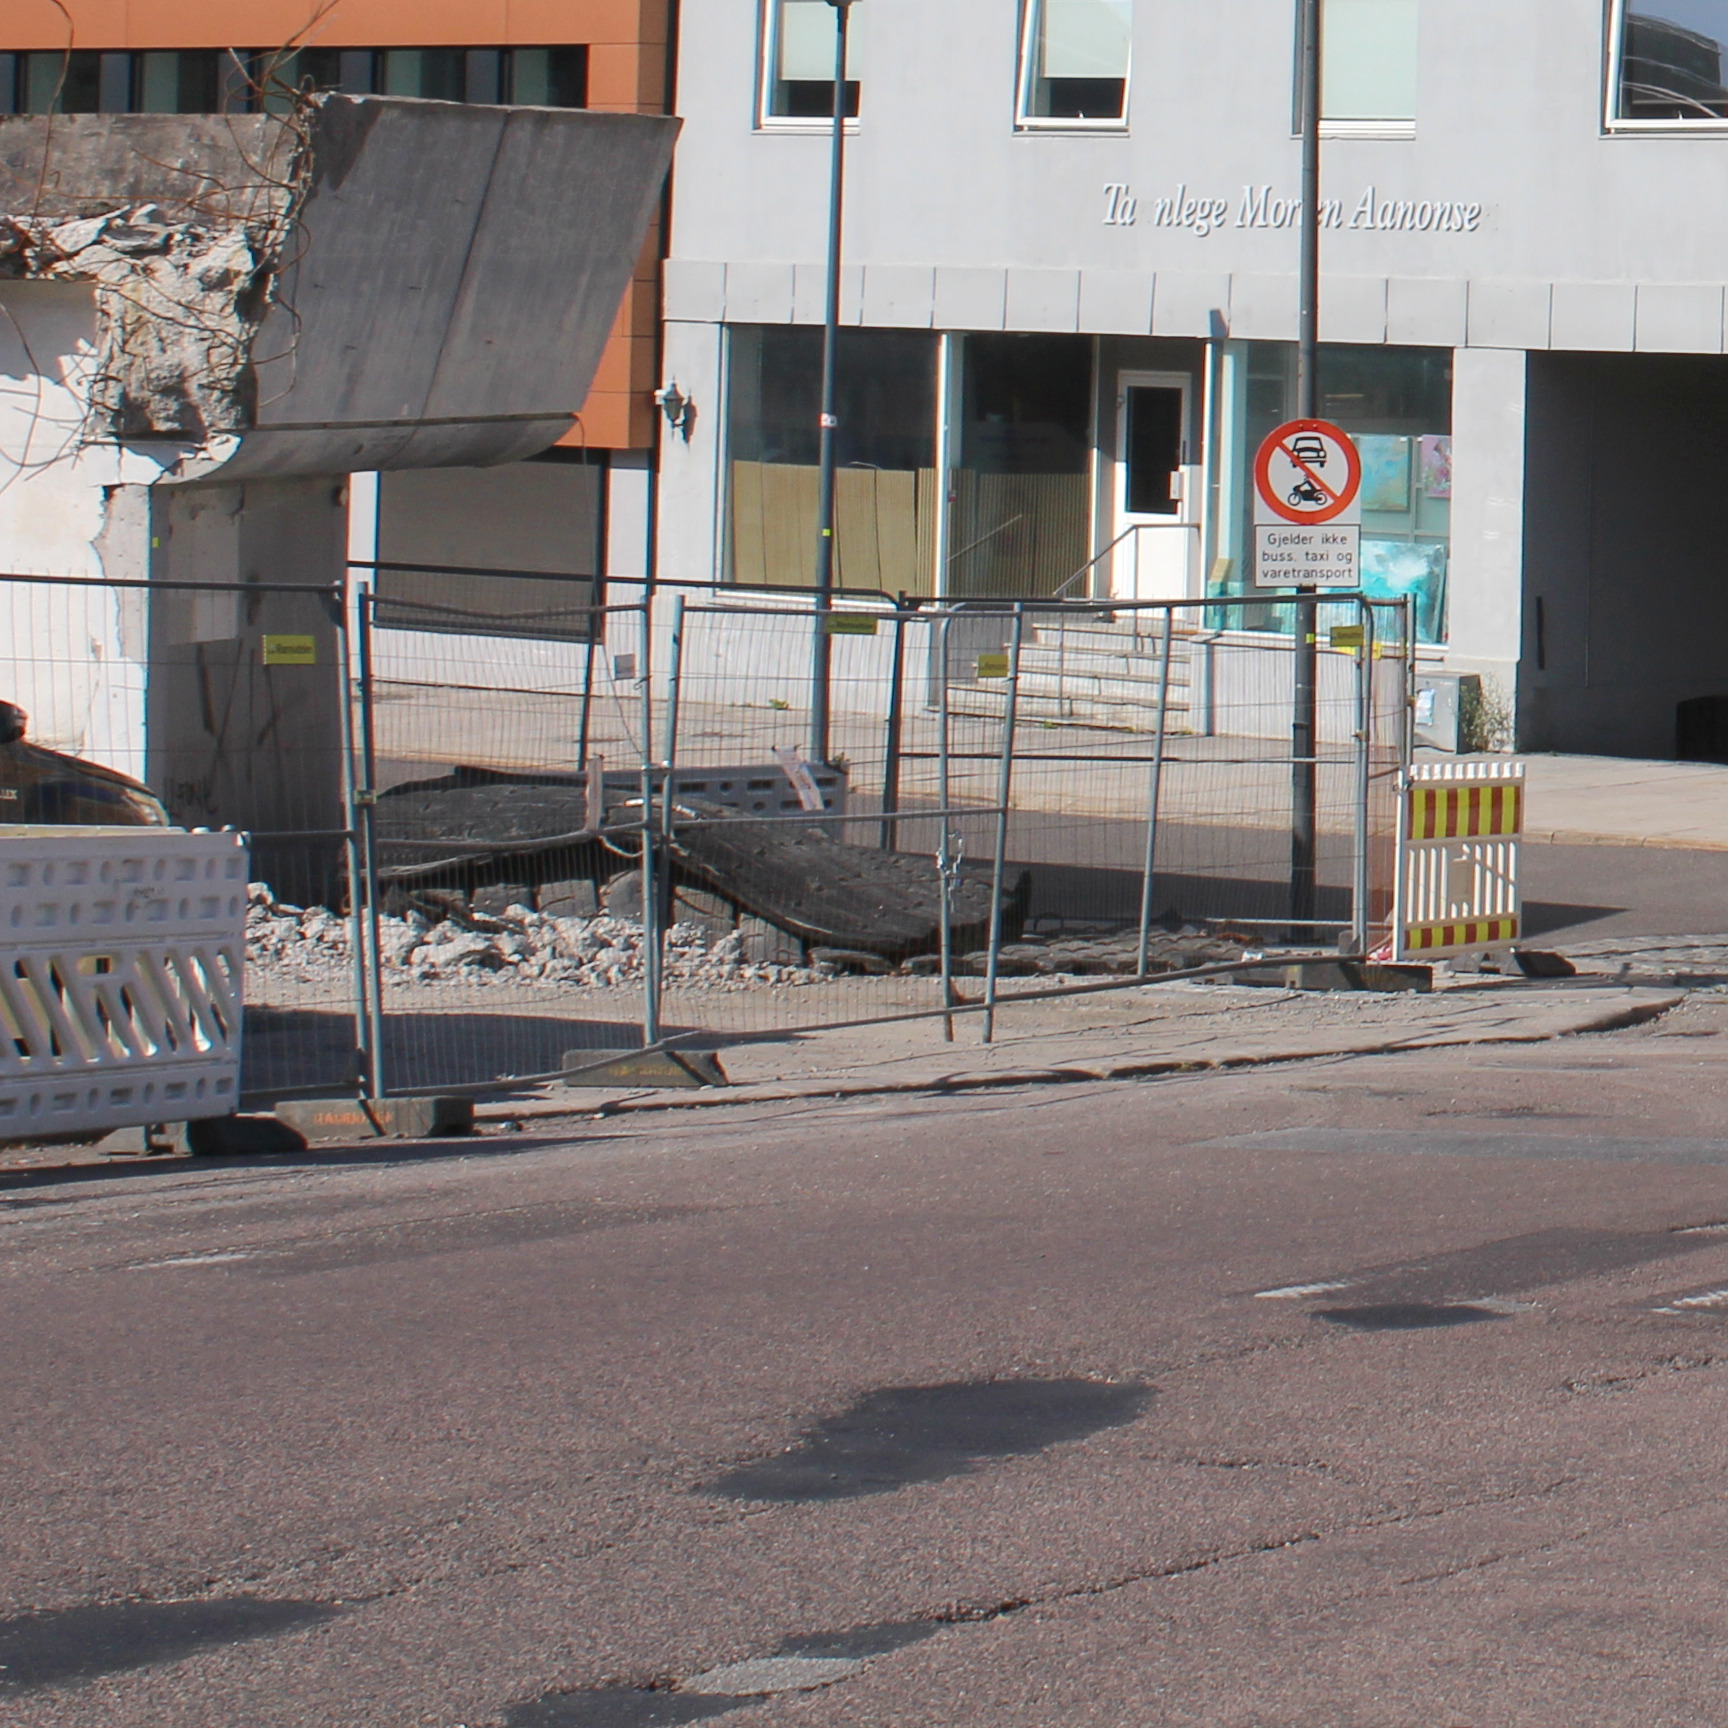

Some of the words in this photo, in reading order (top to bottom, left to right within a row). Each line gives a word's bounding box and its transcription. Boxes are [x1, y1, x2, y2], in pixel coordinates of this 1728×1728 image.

[1234, 184, 1344, 231] Morn
[1348, 184, 1484, 233] Aanonse
[1267, 532, 1314, 548] Gjelder
[1321, 532, 1348, 545] ikke
[1305, 550, 1330, 562] taxi
[1336, 552, 1353, 565] og
[1262, 567, 1353, 580] varetransport
